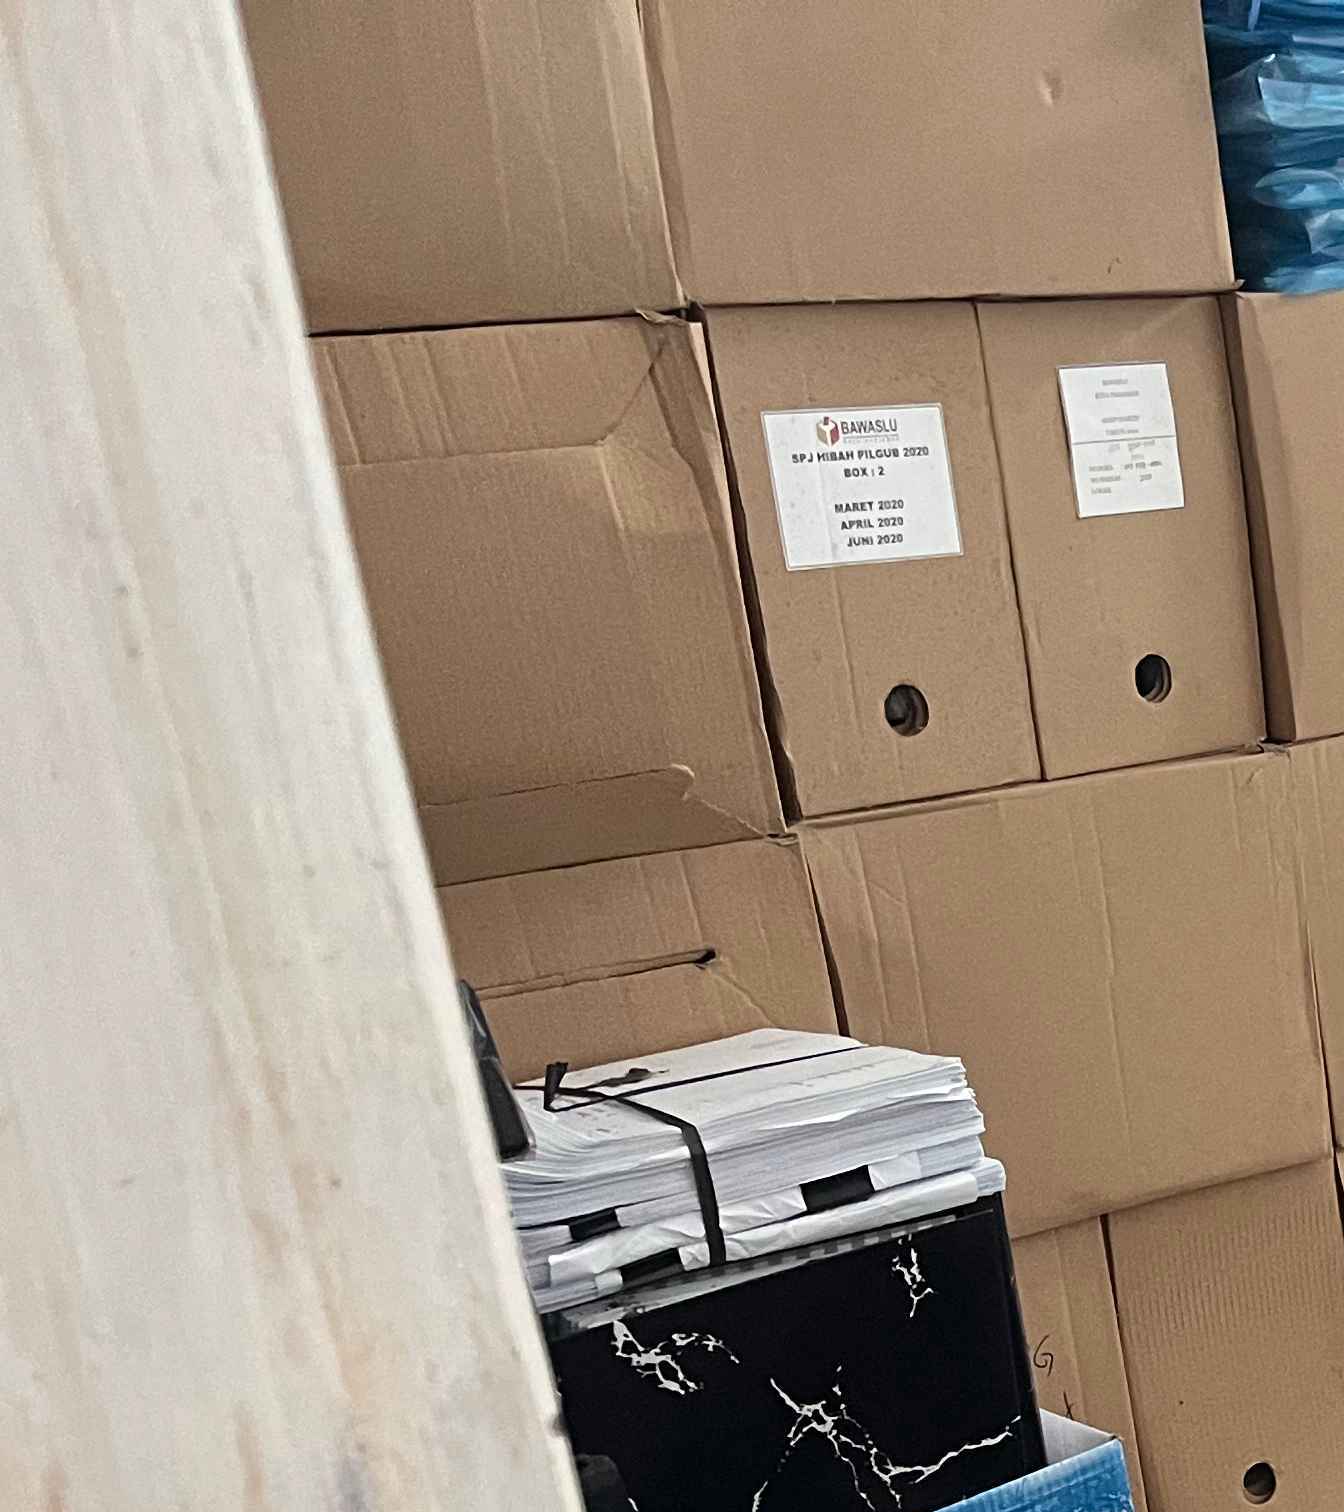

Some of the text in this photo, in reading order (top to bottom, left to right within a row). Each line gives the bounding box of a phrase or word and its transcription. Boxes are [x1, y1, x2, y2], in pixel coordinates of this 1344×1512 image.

[840, 418, 898, 435] BAWASLU
[792, 446, 929, 464] SPJ HIBAH PILGUB 2020
[843, 467, 869, 478] BOX
[877, 466, 886, 477] 2
[834, 499, 905, 513] MARET 2020
[841, 517, 904, 531] APRIL 2020
[847, 533, 904, 547] JUNI 2020
